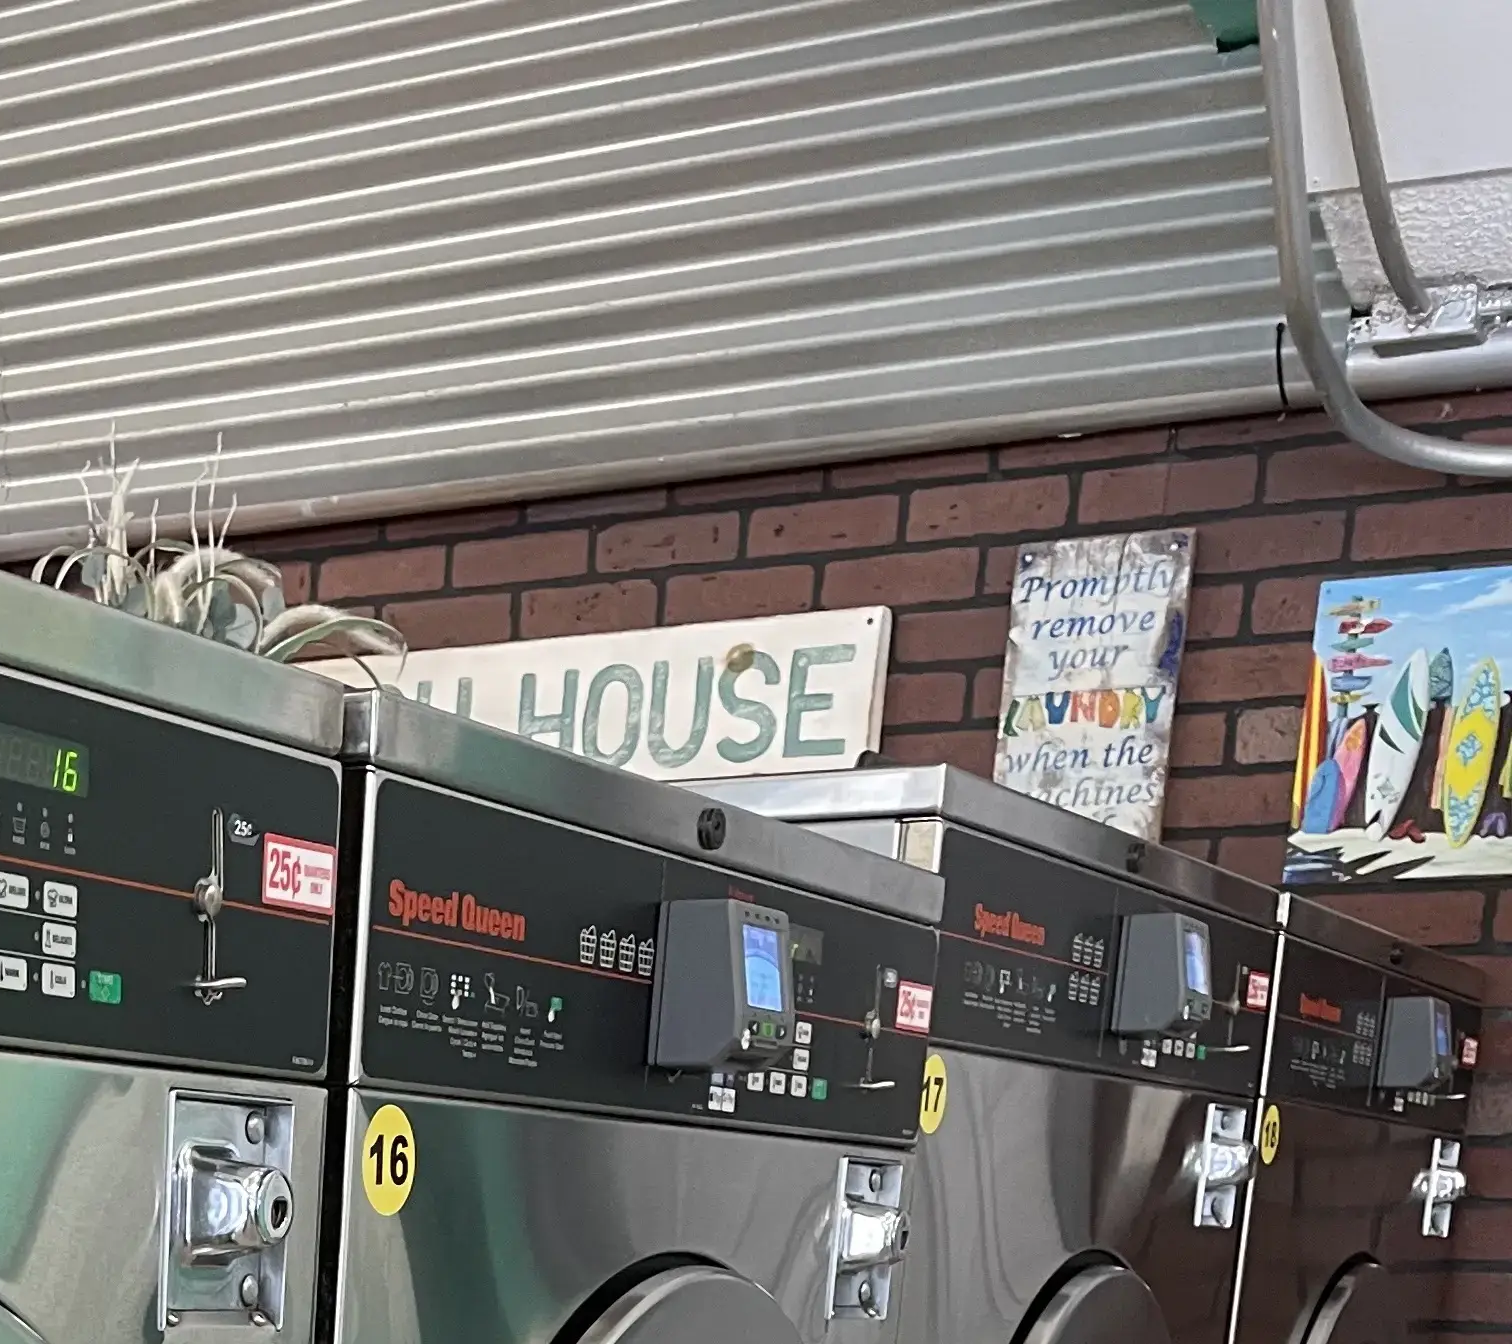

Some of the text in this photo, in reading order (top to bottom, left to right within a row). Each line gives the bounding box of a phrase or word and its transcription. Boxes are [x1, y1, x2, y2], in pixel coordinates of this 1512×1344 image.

[1020, 559, 1174, 606] Promptly
[1031, 611, 1155, 640] remove
[1048, 644, 1128, 681] your
[518, 644, 856, 767] HOUSE
[1003, 685, 1166, 736] LAUNDRY
[52, 749, 78, 792] 16
[1005, 735, 1153, 773] when the
[269, 848, 302, 899] 25¢
[388, 879, 525, 942] Speed Queen
[922, 1075, 944, 1112] 17
[369, 1134, 409, 1186] 16
